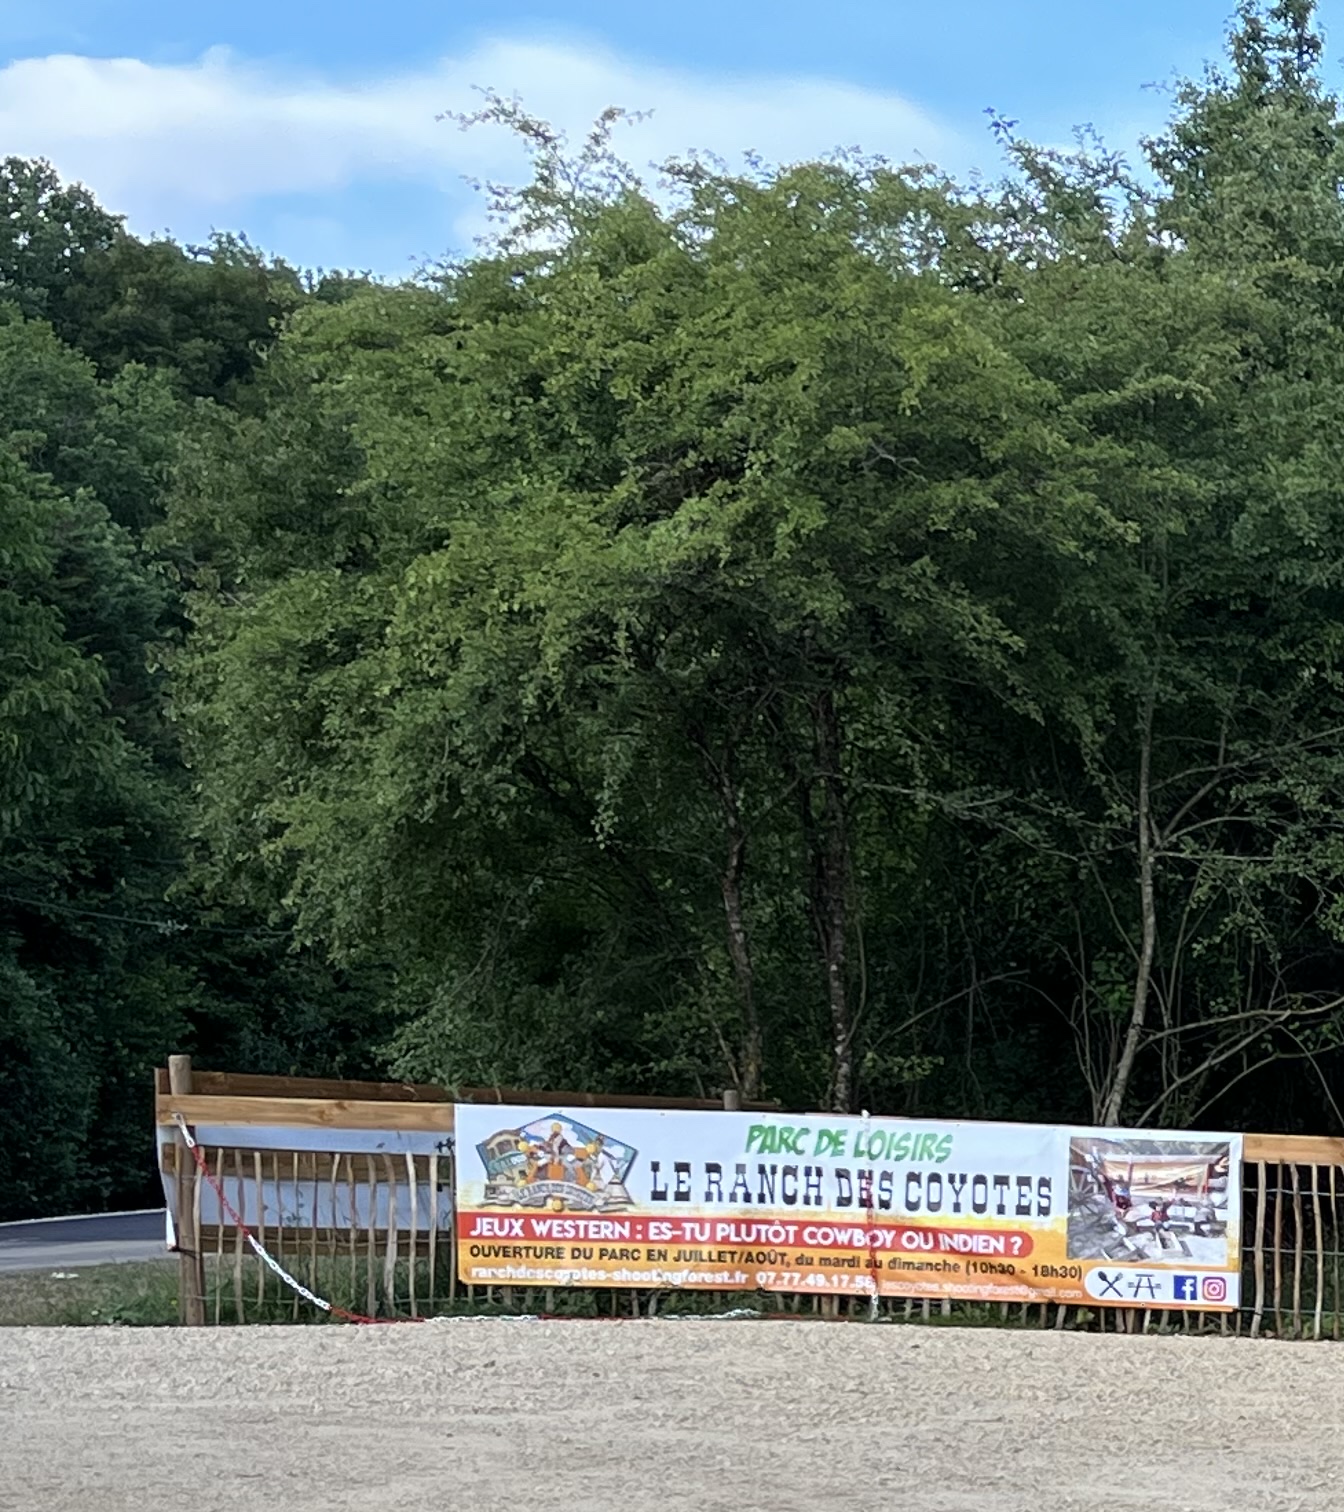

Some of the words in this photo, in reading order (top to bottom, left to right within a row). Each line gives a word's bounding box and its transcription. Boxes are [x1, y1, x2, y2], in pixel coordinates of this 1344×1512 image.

[745, 1124, 811, 1156] PARC
[814, 1128, 849, 1157] DE
[853, 1129, 954, 1163] LOISIRS
[650, 1160, 693, 1202] LE
[704, 1162, 824, 1207] RANCH
[835, 1168, 894, 1210] DES
[905, 1171, 1053, 1217] COYOTES
[470, 1217, 525, 1237] JEUX
[530, 1218, 631, 1239] WESTERN
[635, 1224, 643, 1240] :
[648, 1221, 711, 1241] ES-TU
[716, 1219, 799, 1244] PLUTÔT
[803, 1226, 896, 1248] COWBOY
[901, 1230, 934, 1250] OU
[938, 1233, 1006, 1254] INDIEN
[1010, 1236, 1023, 1256] ?
[470, 1244, 566, 1260] OUVERTURE
[571, 1246, 594, 1260] DU
[599, 1247, 641, 1262] PARC
[646, 1248, 668, 1262] EN
[795, 1253, 814, 1267] du
[819, 1255, 861, 1269] mardi
[865, 1258, 883, 1269] au
[888, 1257, 961, 1273] dimanche
[1031, 1264, 1083, 1282] 18h30)
